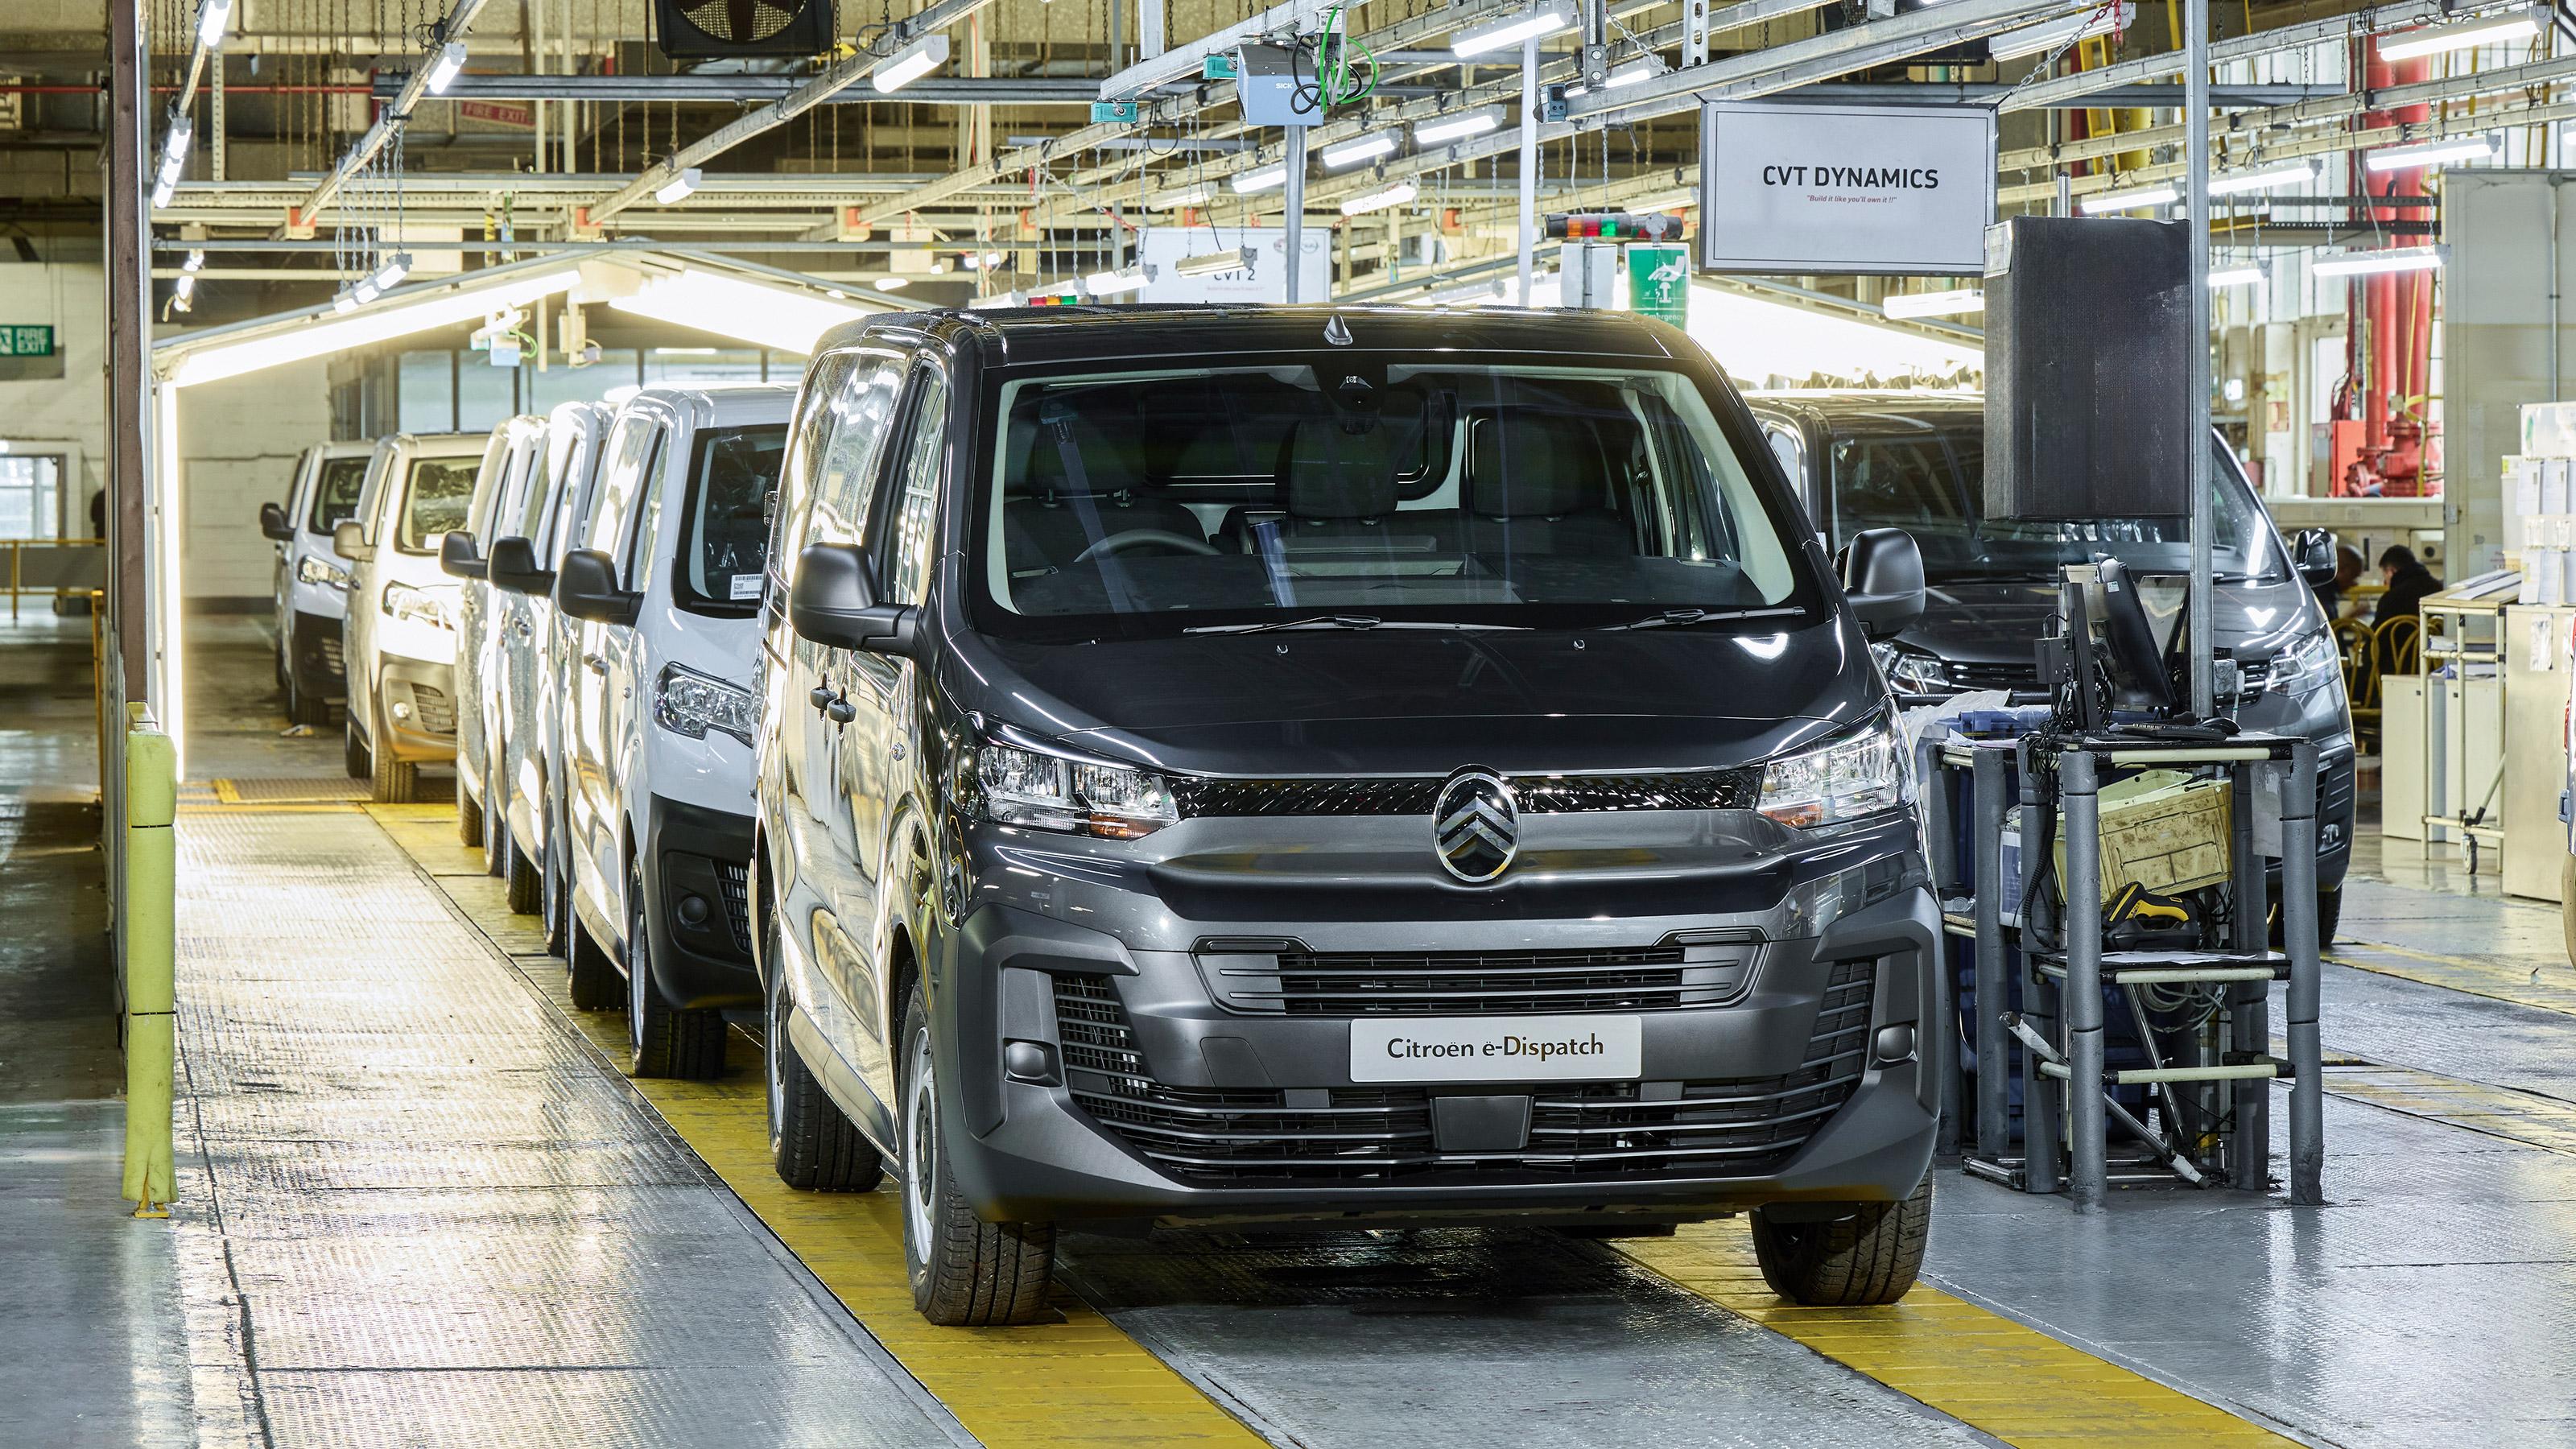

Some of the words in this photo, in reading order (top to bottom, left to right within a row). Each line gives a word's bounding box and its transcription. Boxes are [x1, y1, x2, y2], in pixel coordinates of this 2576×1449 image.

[1763, 166, 1808, 186] CVT
[1814, 167, 1938, 189] DYNAMICS
[1847, 196, 1866, 204] you'll
[1248, 268, 1255, 281] 2
[17, 328, 47, 341] FIRE
[17, 340, 47, 353] EXIT
[1387, 1038, 1474, 1059] Citroën
[1482, 1033, 1604, 1062] ë-Dispatch
